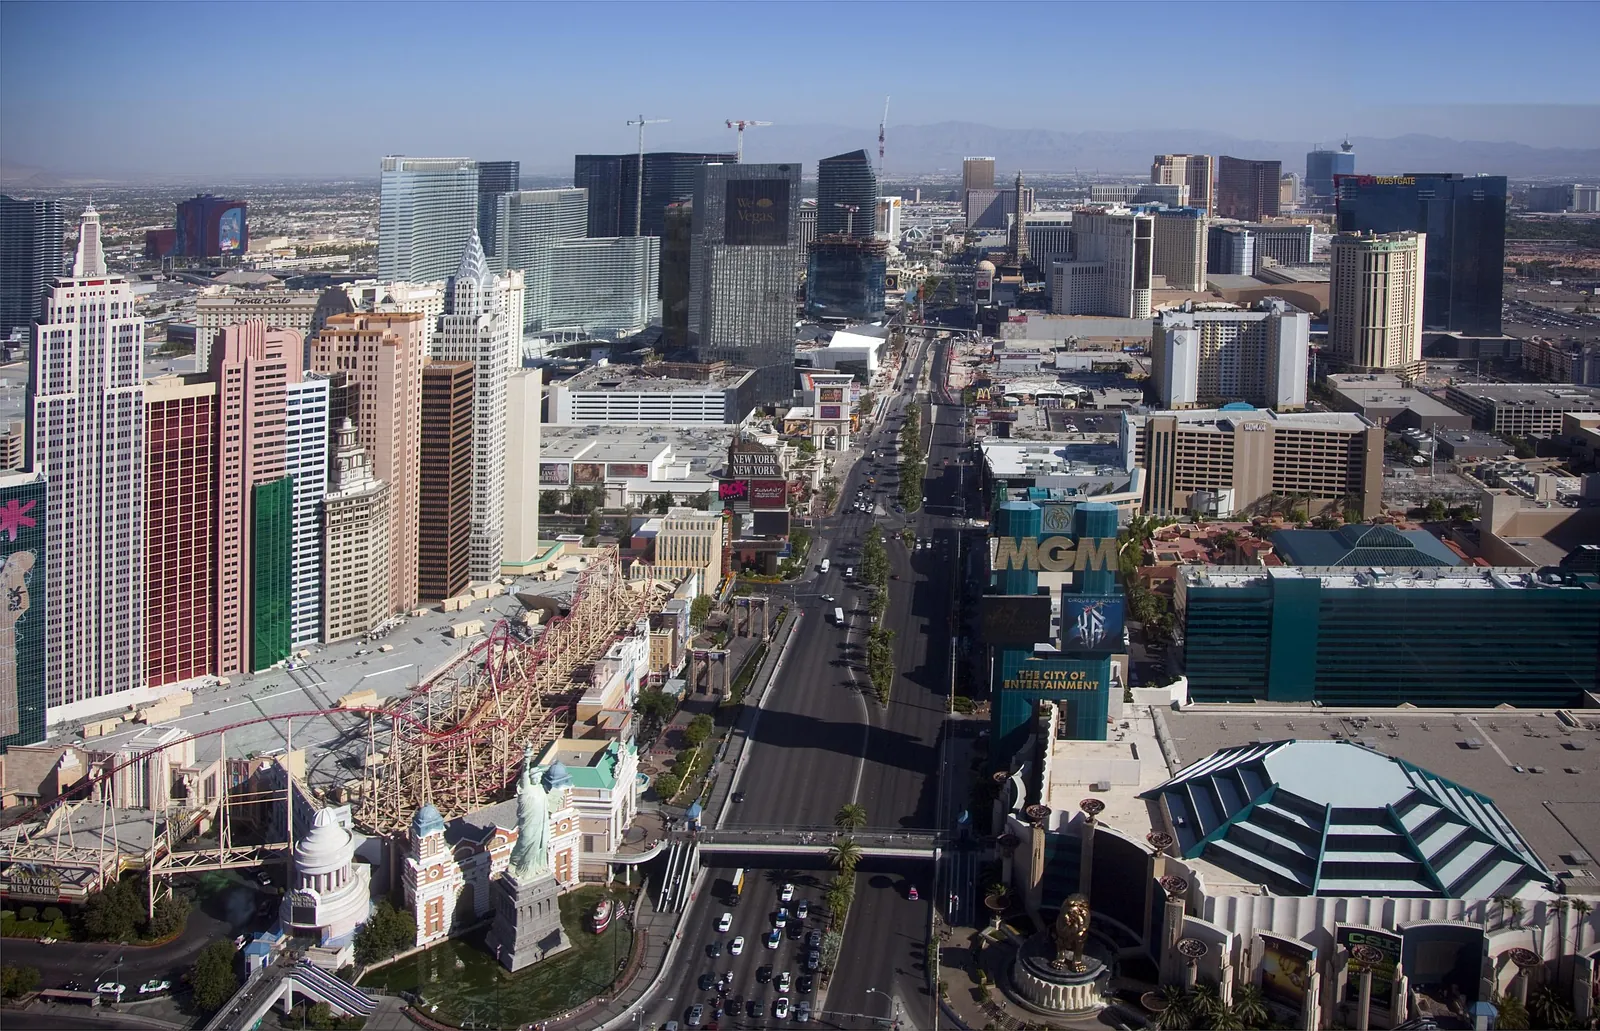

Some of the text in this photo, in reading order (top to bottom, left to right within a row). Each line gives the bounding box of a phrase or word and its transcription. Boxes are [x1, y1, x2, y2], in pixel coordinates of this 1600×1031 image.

[1376, 175, 1415, 185] WESTGATE
[737, 197, 753, 208] We
[234, 297, 291, 305] Monte Carlo
[733, 455, 776, 464] NEW YORK
[733, 466, 776, 475] NEW YORK
[993, 535, 1119, 572] MGM
[1018, 670, 1086, 680] THE CITY OF
[1004, 680, 1099, 690] ENTERTAINMENT
[11, 876, 57, 887] NEW YORK
[11, 885, 57, 895] NEW YORK
